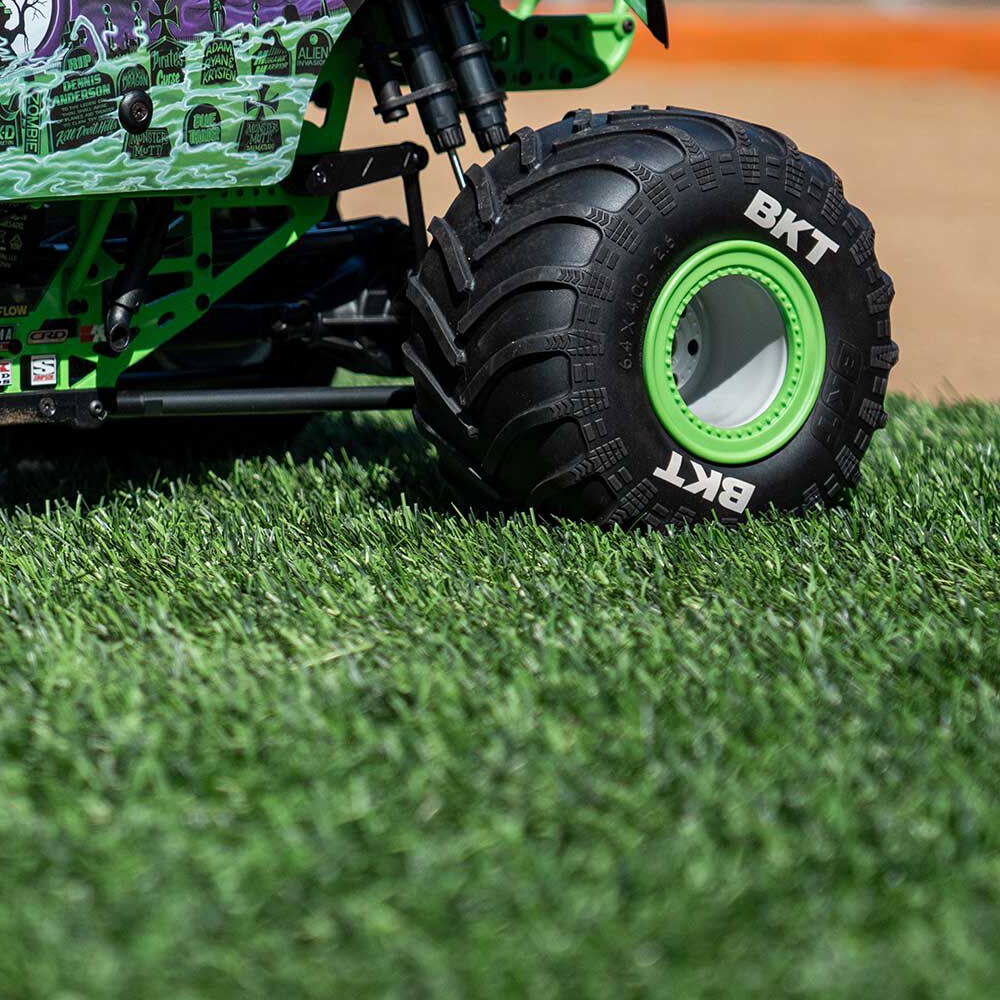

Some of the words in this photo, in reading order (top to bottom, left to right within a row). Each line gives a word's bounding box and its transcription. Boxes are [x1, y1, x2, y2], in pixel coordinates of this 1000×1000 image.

[206, 41, 233, 56] ADAM
[297, 47, 329, 59] ALIEN
[67, 55, 92, 71] RIP
[153, 51, 184, 70] Pirate's
[63, 74, 101, 91] DENNIS
[157, 70, 181, 86] Curse
[203, 68, 237, 84] KRISTEN
[53, 84, 111, 106] ANDERSON
[26, 92, 40, 153] ZOMBIE
[743, 189, 840, 265] BKT
[652, 450, 756, 514] BKT
